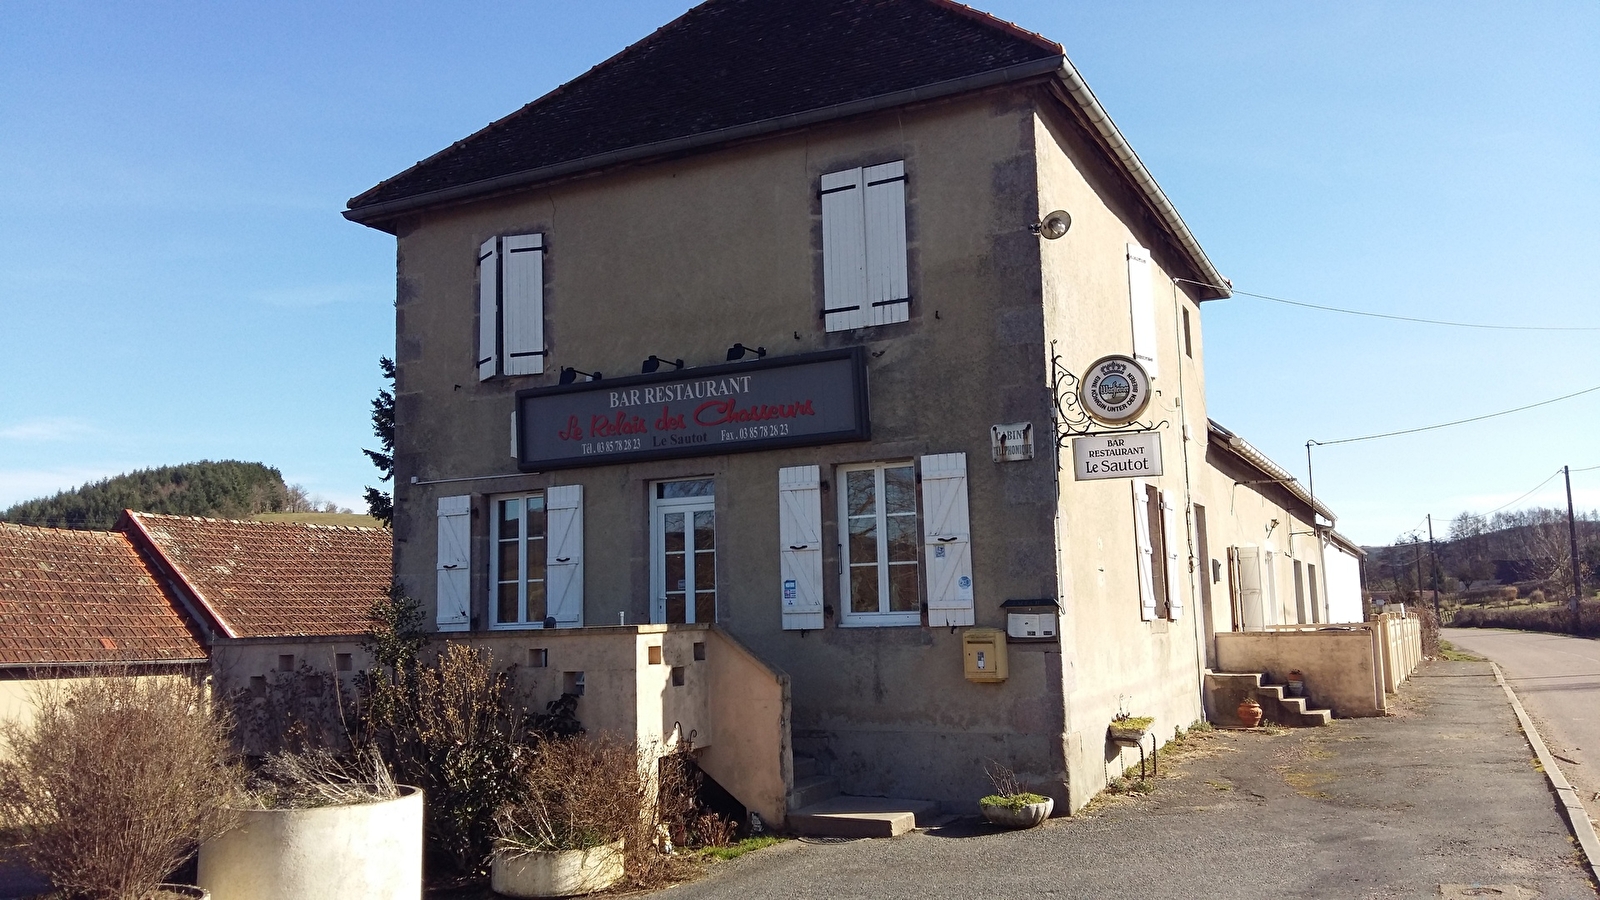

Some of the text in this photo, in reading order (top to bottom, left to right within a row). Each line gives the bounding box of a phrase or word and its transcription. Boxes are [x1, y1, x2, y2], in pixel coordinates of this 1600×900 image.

[610, 376, 751, 408] BAR RESTAURANT
[1106, 404, 1128, 412] UNTER
[1126, 394, 1137, 406] DEN
[558, 398, 816, 440] Le Relais des Chasseurs
[740, 427, 748, 439] 03
[749, 427, 758, 438] 85
[760, 426, 768, 437] 78
[770, 425, 778, 436] 28
[780, 424, 788, 436] 23
[597, 442, 604, 453] 03
[606, 442, 613, 452] 85
[615, 440, 622, 451] 78
[624, 439, 632, 450] 28
[633, 438, 641, 450] 23
[652, 432, 707, 447] Le Sautot
[1107, 439, 1124, 447] BAR
[1089, 447, 1144, 458] RESTAURANT
[1086, 458, 1149, 473] Le Sautot
